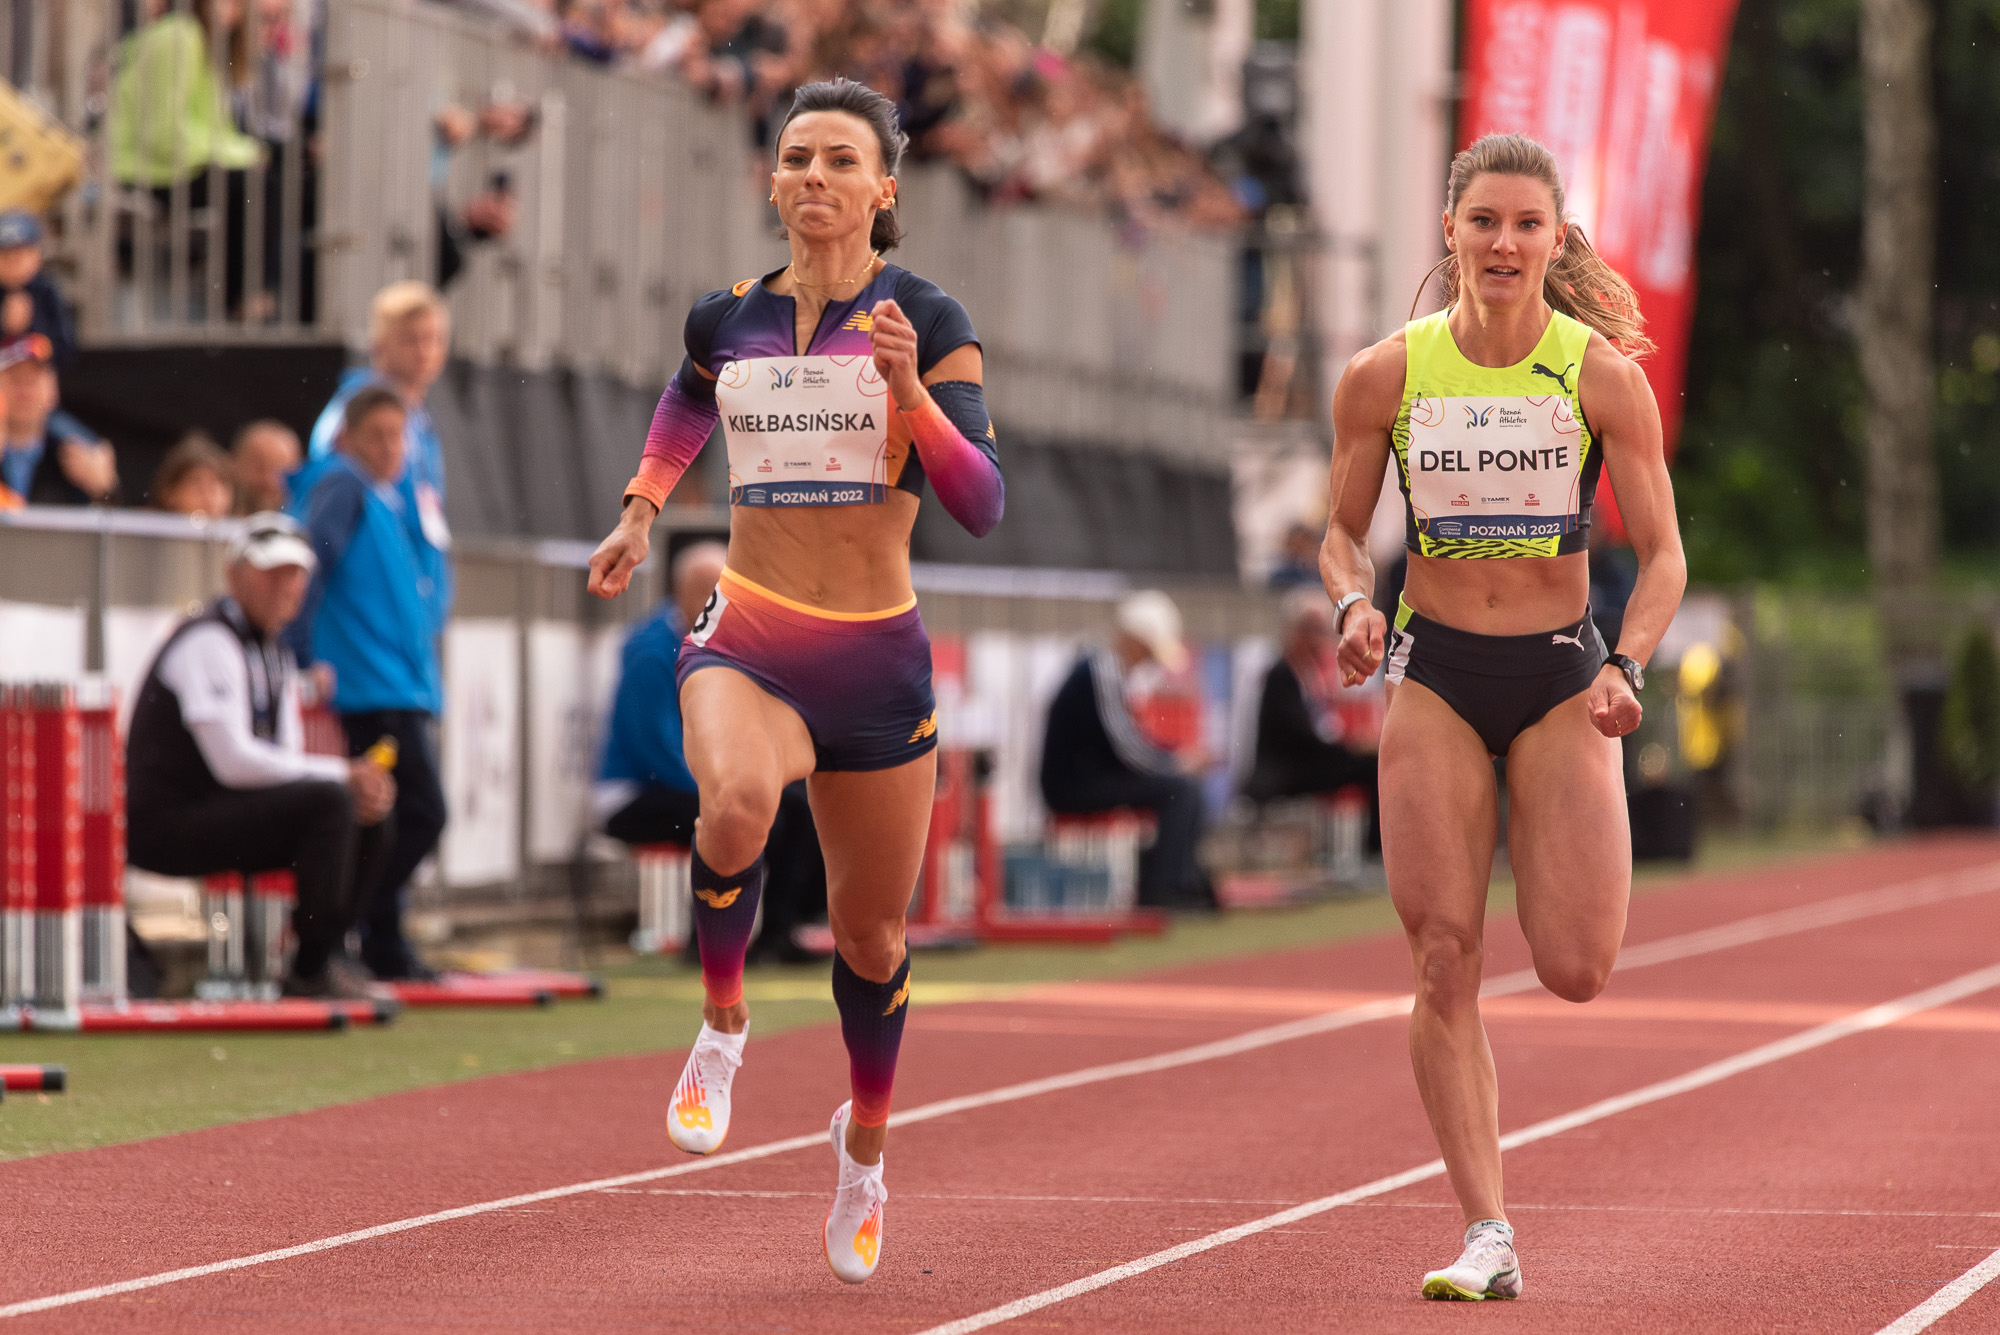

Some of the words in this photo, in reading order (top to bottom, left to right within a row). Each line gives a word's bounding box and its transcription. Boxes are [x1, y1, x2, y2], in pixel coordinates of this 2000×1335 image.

[803, 367, 824, 375] Poznań
[802, 376, 830, 384] Athletics
[1500, 407, 1522, 415] Poznań
[728, 409, 876, 432] KIEŁBASIŃSKA
[1420, 450, 1470, 472] DEL
[1478, 446, 1569, 472] PONTE
[772, 490, 828, 504] POZNAŃ
[832, 490, 864, 502] 2022
[1469, 523, 1527, 536] POZNAŃ
[1529, 522, 1561, 536] 2022
